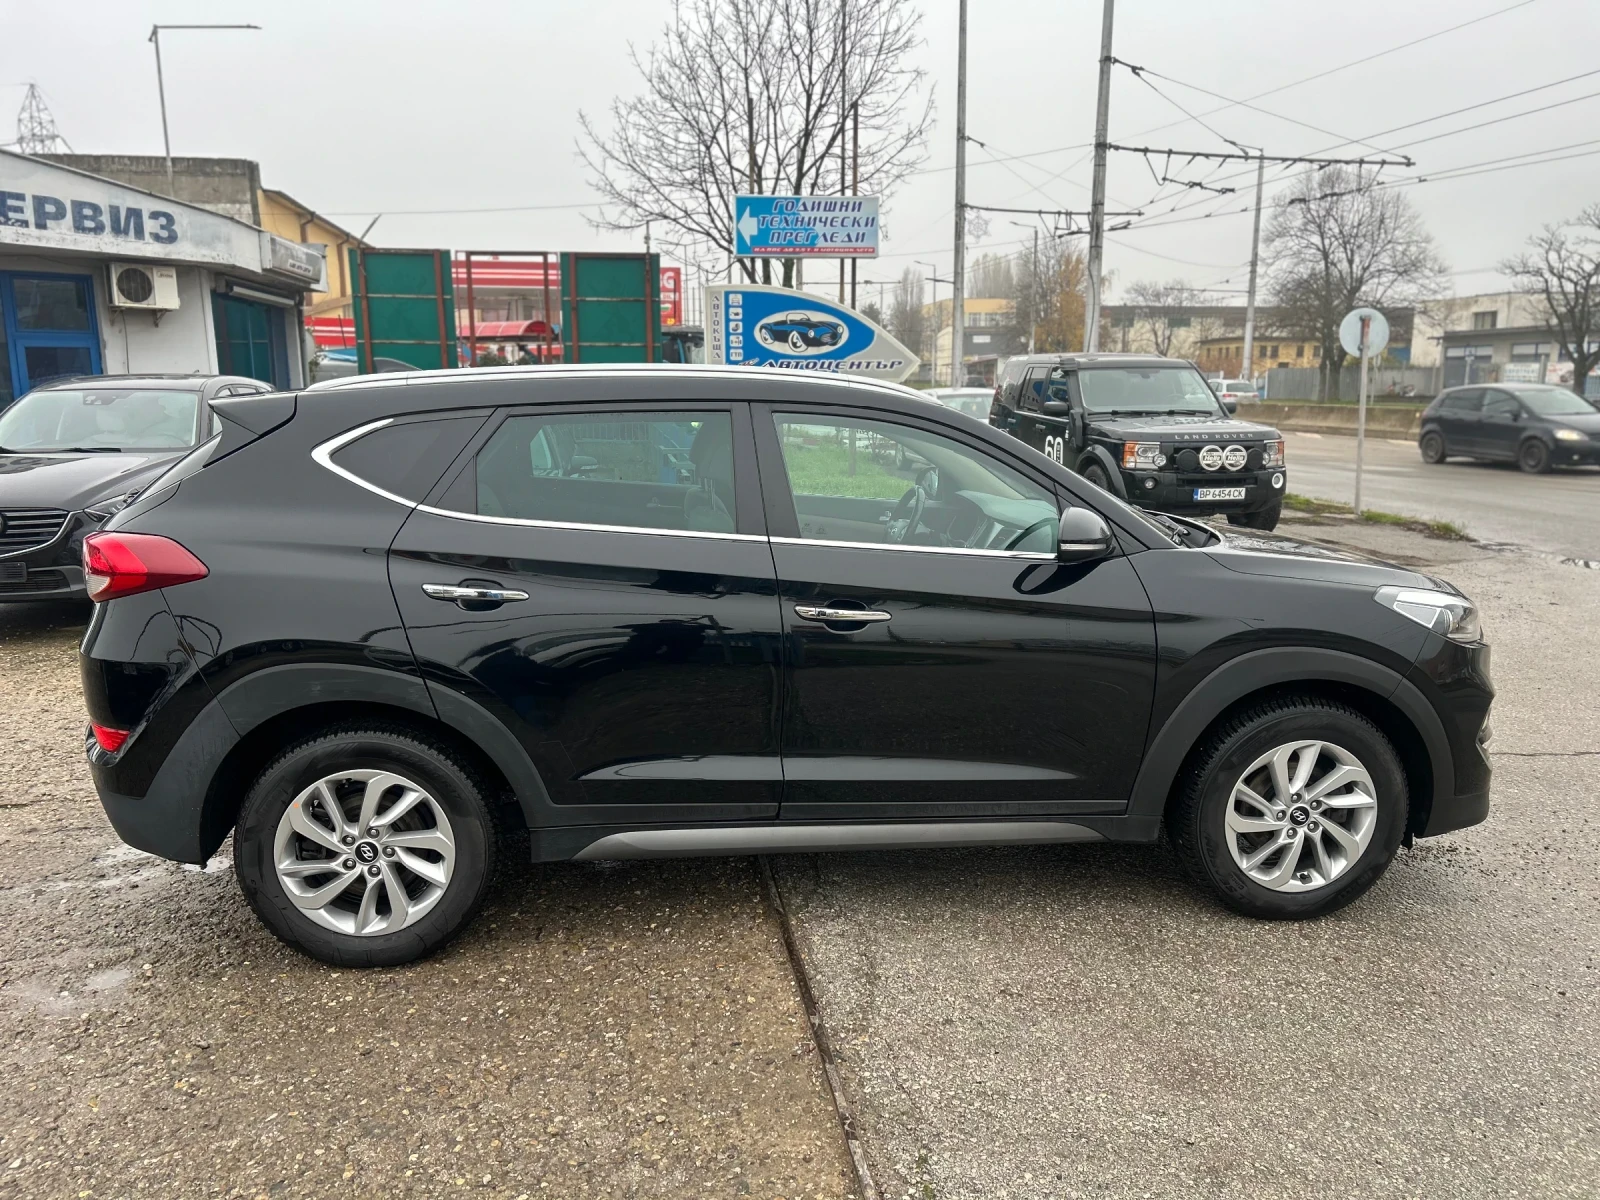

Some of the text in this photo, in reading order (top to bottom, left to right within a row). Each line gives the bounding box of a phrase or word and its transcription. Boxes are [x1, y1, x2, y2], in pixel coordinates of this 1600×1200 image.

[773, 200, 863, 212] ГОДИШНИ
[760, 215, 876, 228] ТЕХНИЧЕСКИ
[769, 231, 866, 243] ПРЕГЛЕДИ
[712, 295, 721, 359] АВТОКЪЩА
[762, 360, 903, 371] АВТОЦЕНТЪР
[1044, 434, 1064, 465] 60
[1212, 489, 1232, 499] 6454
